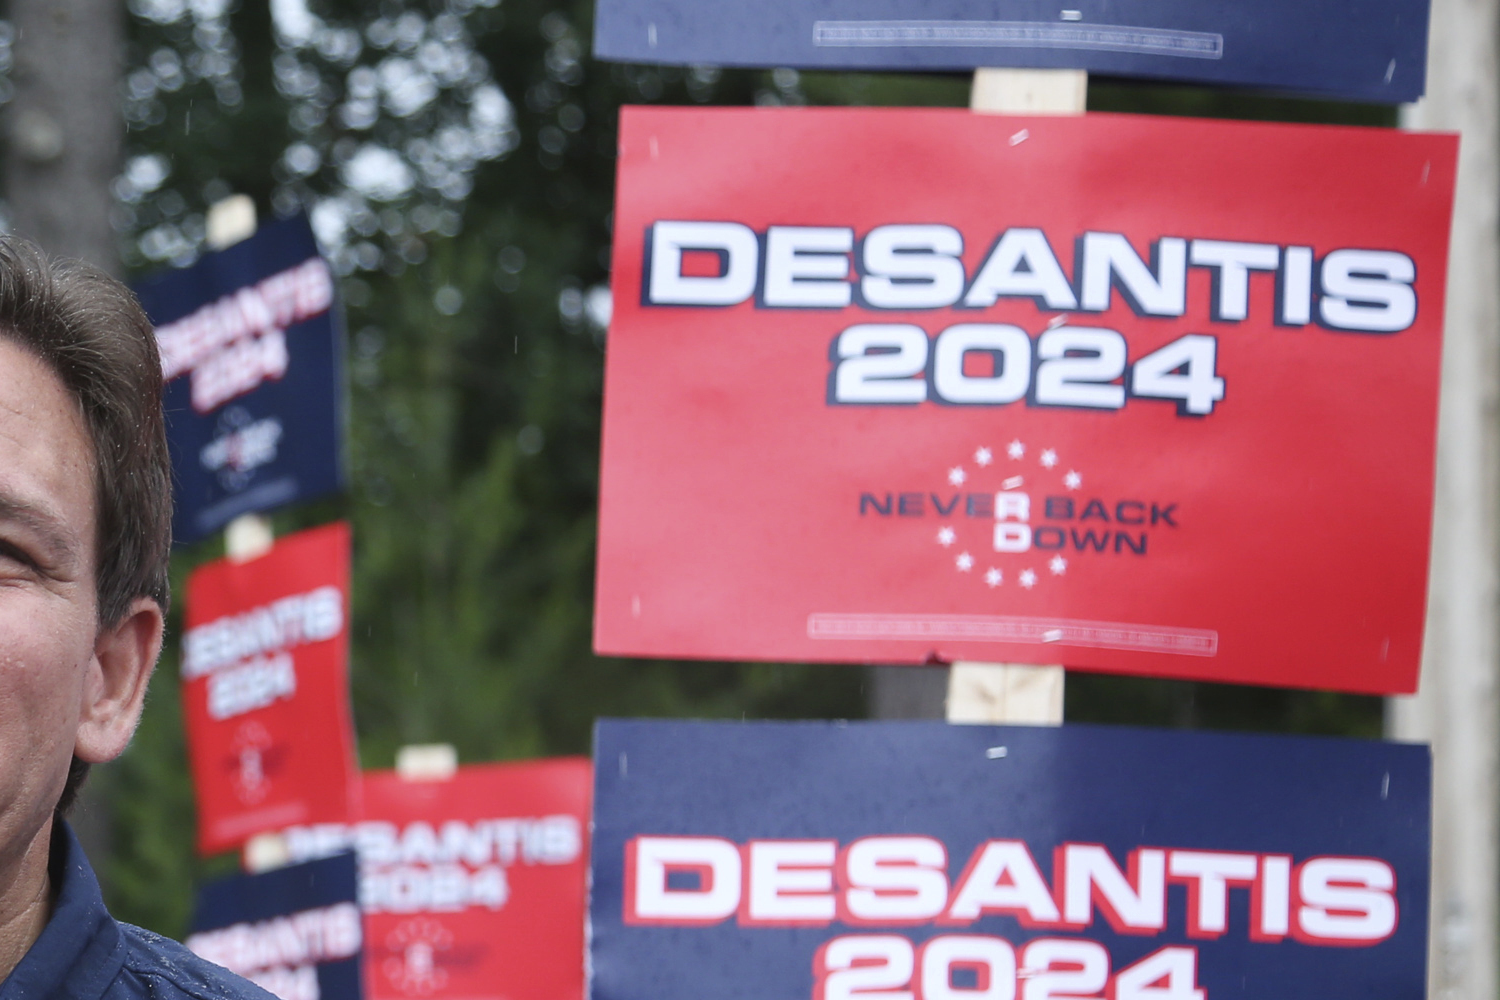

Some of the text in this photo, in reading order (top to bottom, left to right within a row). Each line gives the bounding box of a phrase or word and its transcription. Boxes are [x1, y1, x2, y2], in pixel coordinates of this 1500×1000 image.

[642, 219, 1419, 333] DESANTIS
[827, 322, 1227, 418] 2024
[858, 491, 1179, 528] NEVER BACK
[993, 522, 1150, 556] DOWN
[623, 835, 1400, 948] DESANTIS
